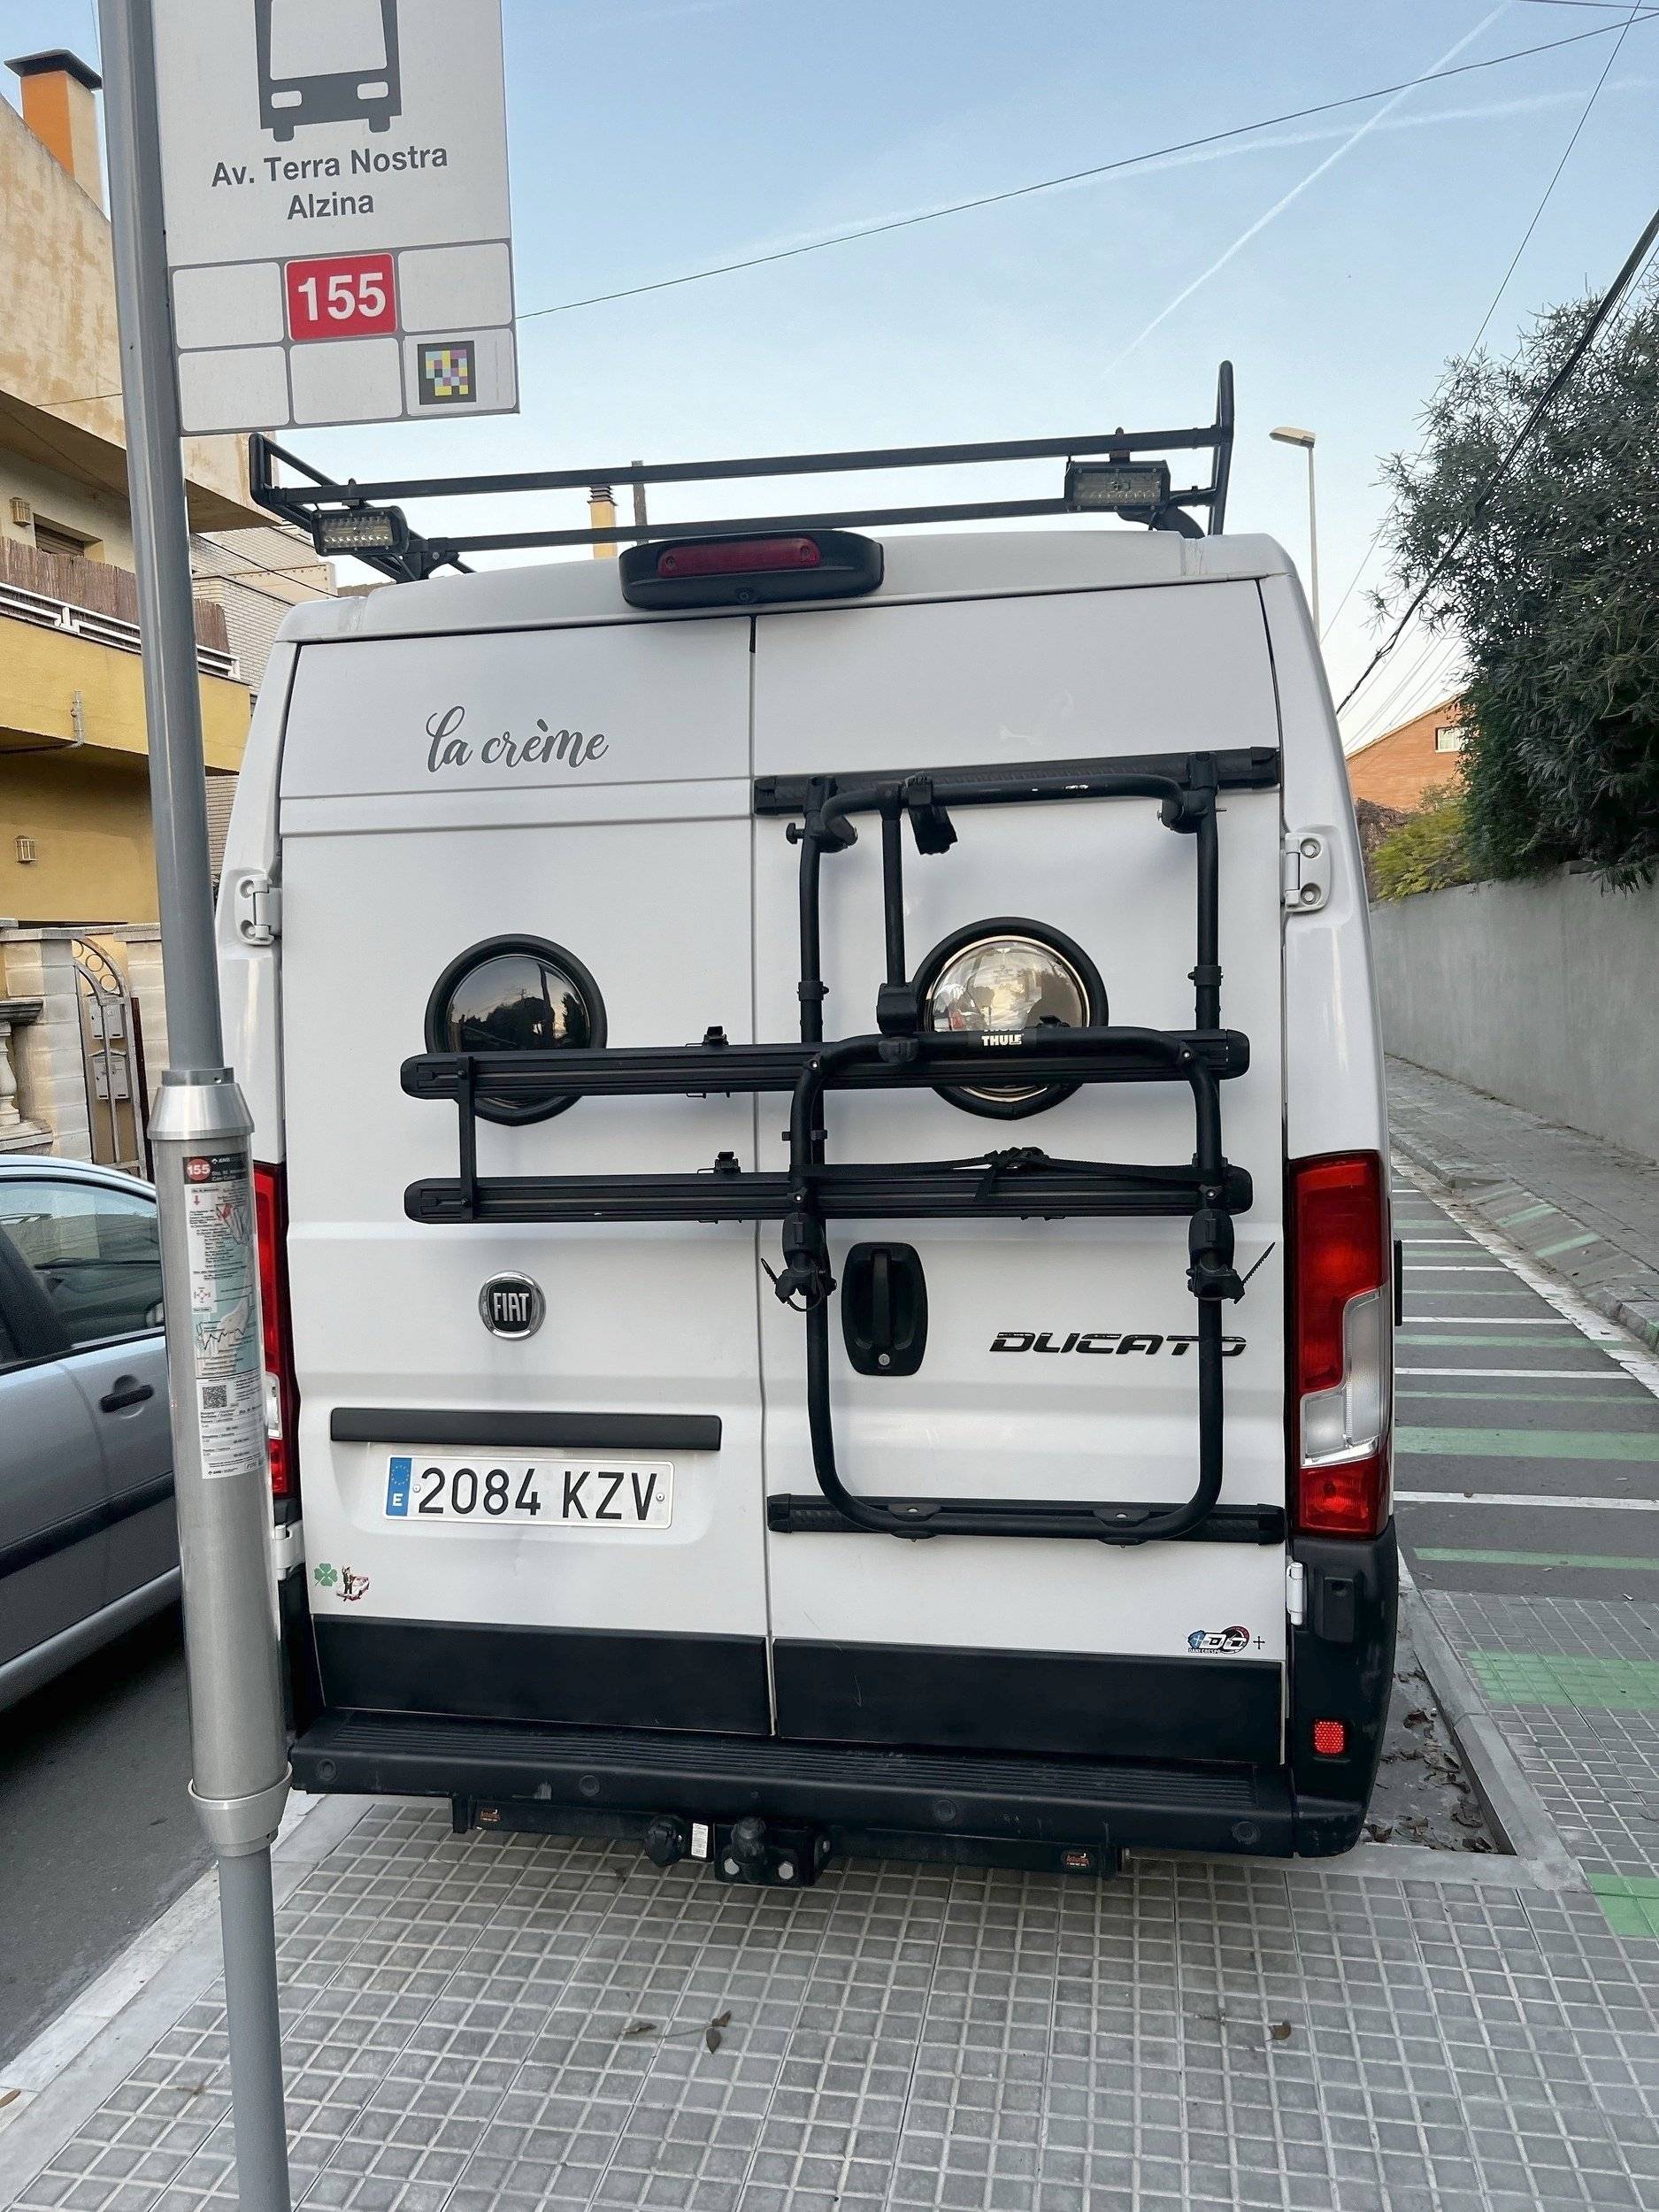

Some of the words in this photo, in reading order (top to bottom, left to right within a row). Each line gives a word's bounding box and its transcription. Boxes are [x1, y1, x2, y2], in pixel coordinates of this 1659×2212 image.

[211, 162, 255, 187] Av.
[263, 155, 341, 182] Terra
[351, 144, 449, 174] Nostra
[287, 191, 374, 220] Alzina
[297, 272, 387, 322] 155
[426, 705, 473, 772] la
[481, 718, 610, 768] crème
[981, 1033, 1023, 1047] THULE
[187, 1164, 211, 1176] 155
[493, 1292, 529, 1322] FIAT
[392, 1493, 403, 1507] E
[418, 1467, 541, 1517] 2084
[562, 1471, 658, 1521] KZV
